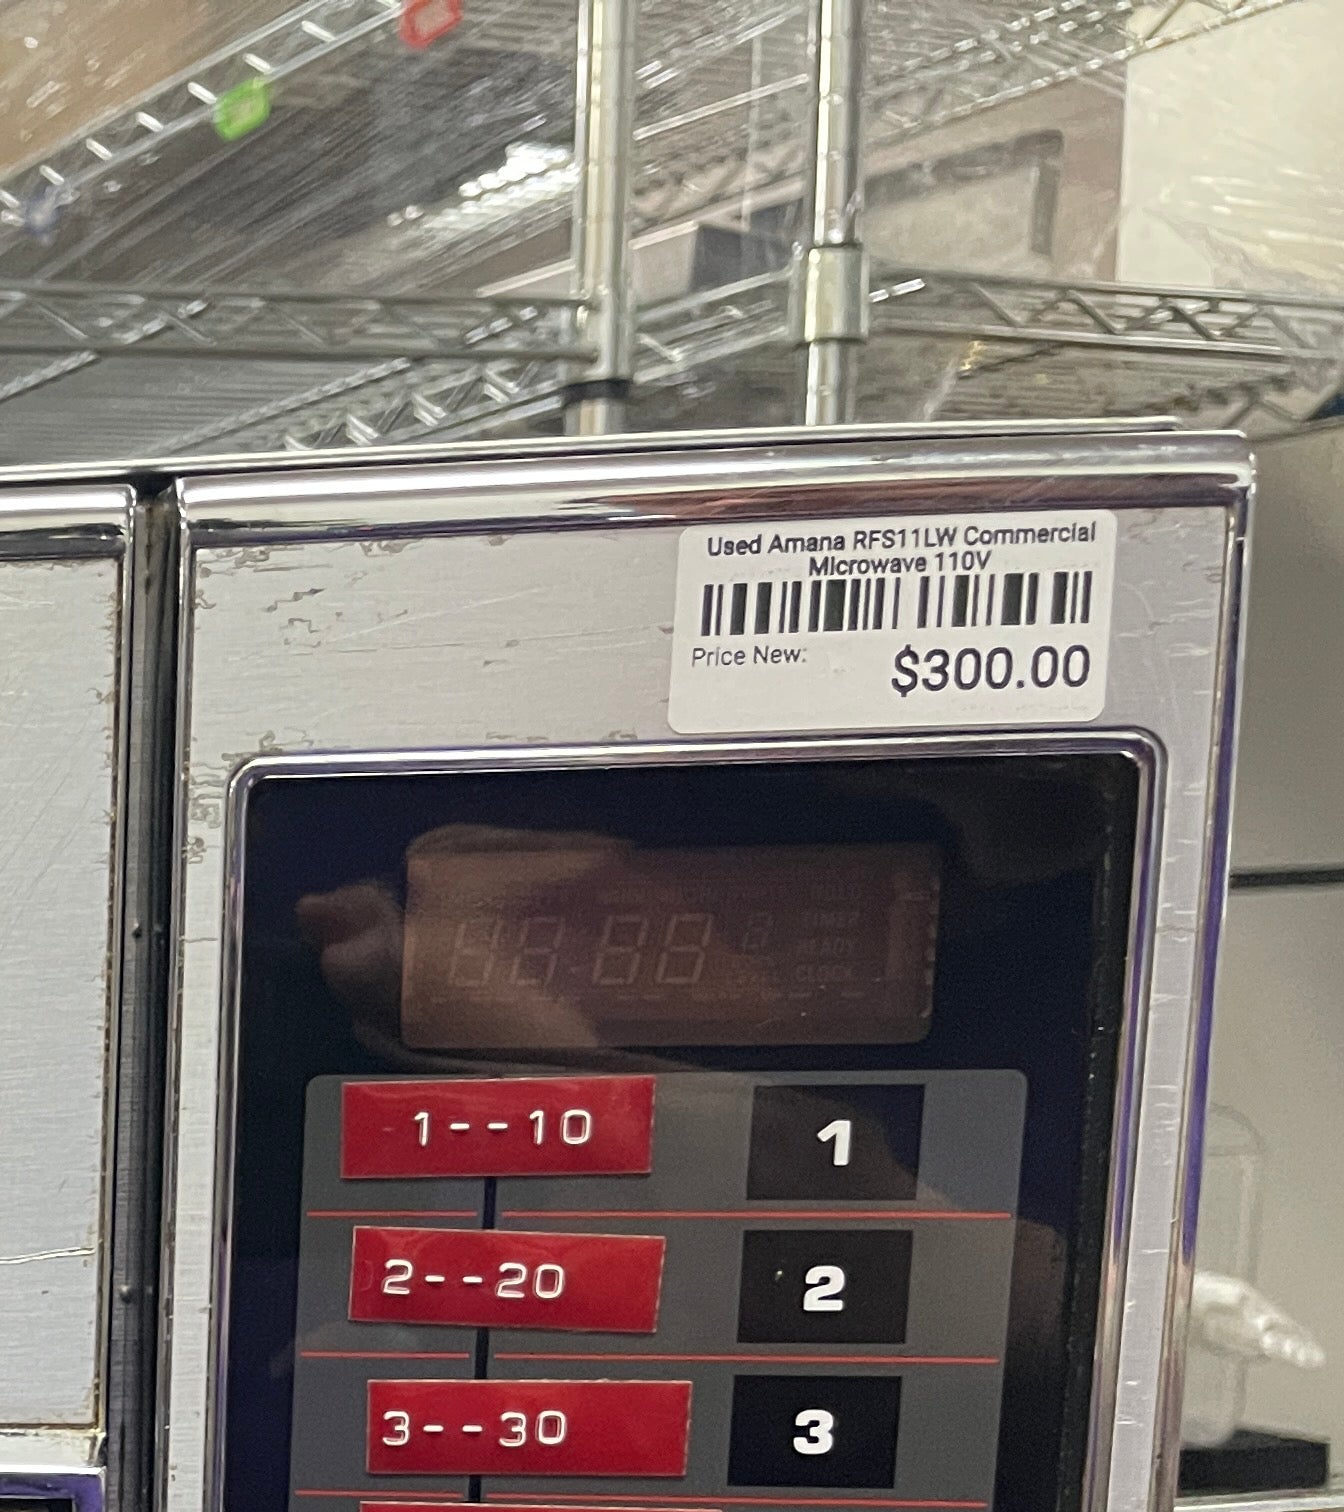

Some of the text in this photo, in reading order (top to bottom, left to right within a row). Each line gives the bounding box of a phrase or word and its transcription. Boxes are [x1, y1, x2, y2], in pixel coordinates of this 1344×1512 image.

[707, 521, 1096, 557] Used Amana RFS11LW Commercial
[808, 550, 992, 577] Microwave 110V
[692, 646, 808, 666] Price New:
[891, 644, 1091, 698] $300.00
[818, 1120, 851, 1165] 1
[804, 1266, 845, 1311] 2
[794, 1410, 833, 1454] 3
